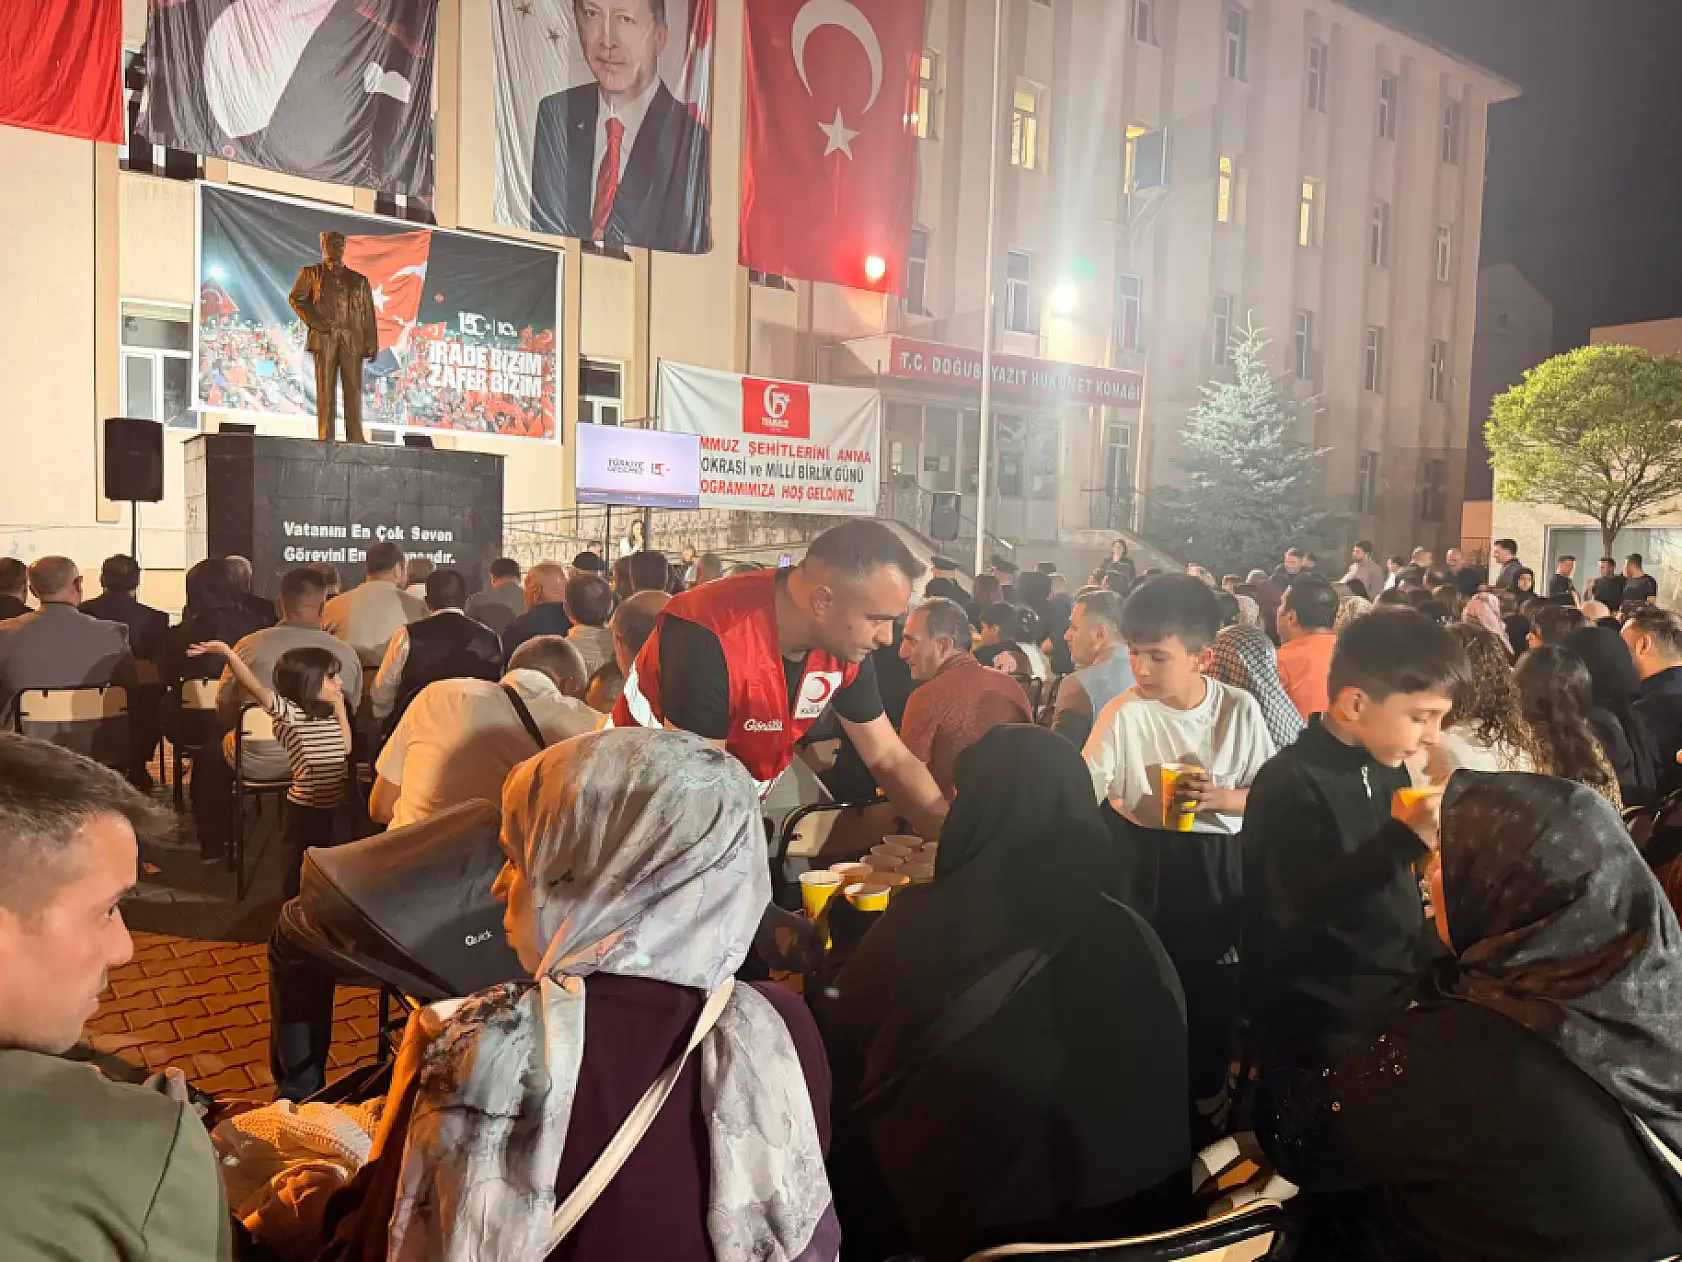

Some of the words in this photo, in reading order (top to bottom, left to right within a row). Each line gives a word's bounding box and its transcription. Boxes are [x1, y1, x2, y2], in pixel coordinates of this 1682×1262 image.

[932, 357, 1027, 386] DOĞUBYAZIT
[700, 436, 740, 453] MMUZ
[748, 440, 831, 460] ŞEHİTLERİNİ
[836, 449, 871, 464] ANMA
[701, 456, 746, 475] OKRASİ
[765, 460, 796, 480] MİLLİ
[835, 464, 864, 483] GÜNÜ
[700, 479, 775, 498] OGRAMIMIZA
[782, 485, 804, 502] HOŞ
[351, 524, 370, 539] En
[376, 524, 405, 542] Çok
[347, 548, 367, 562] En
